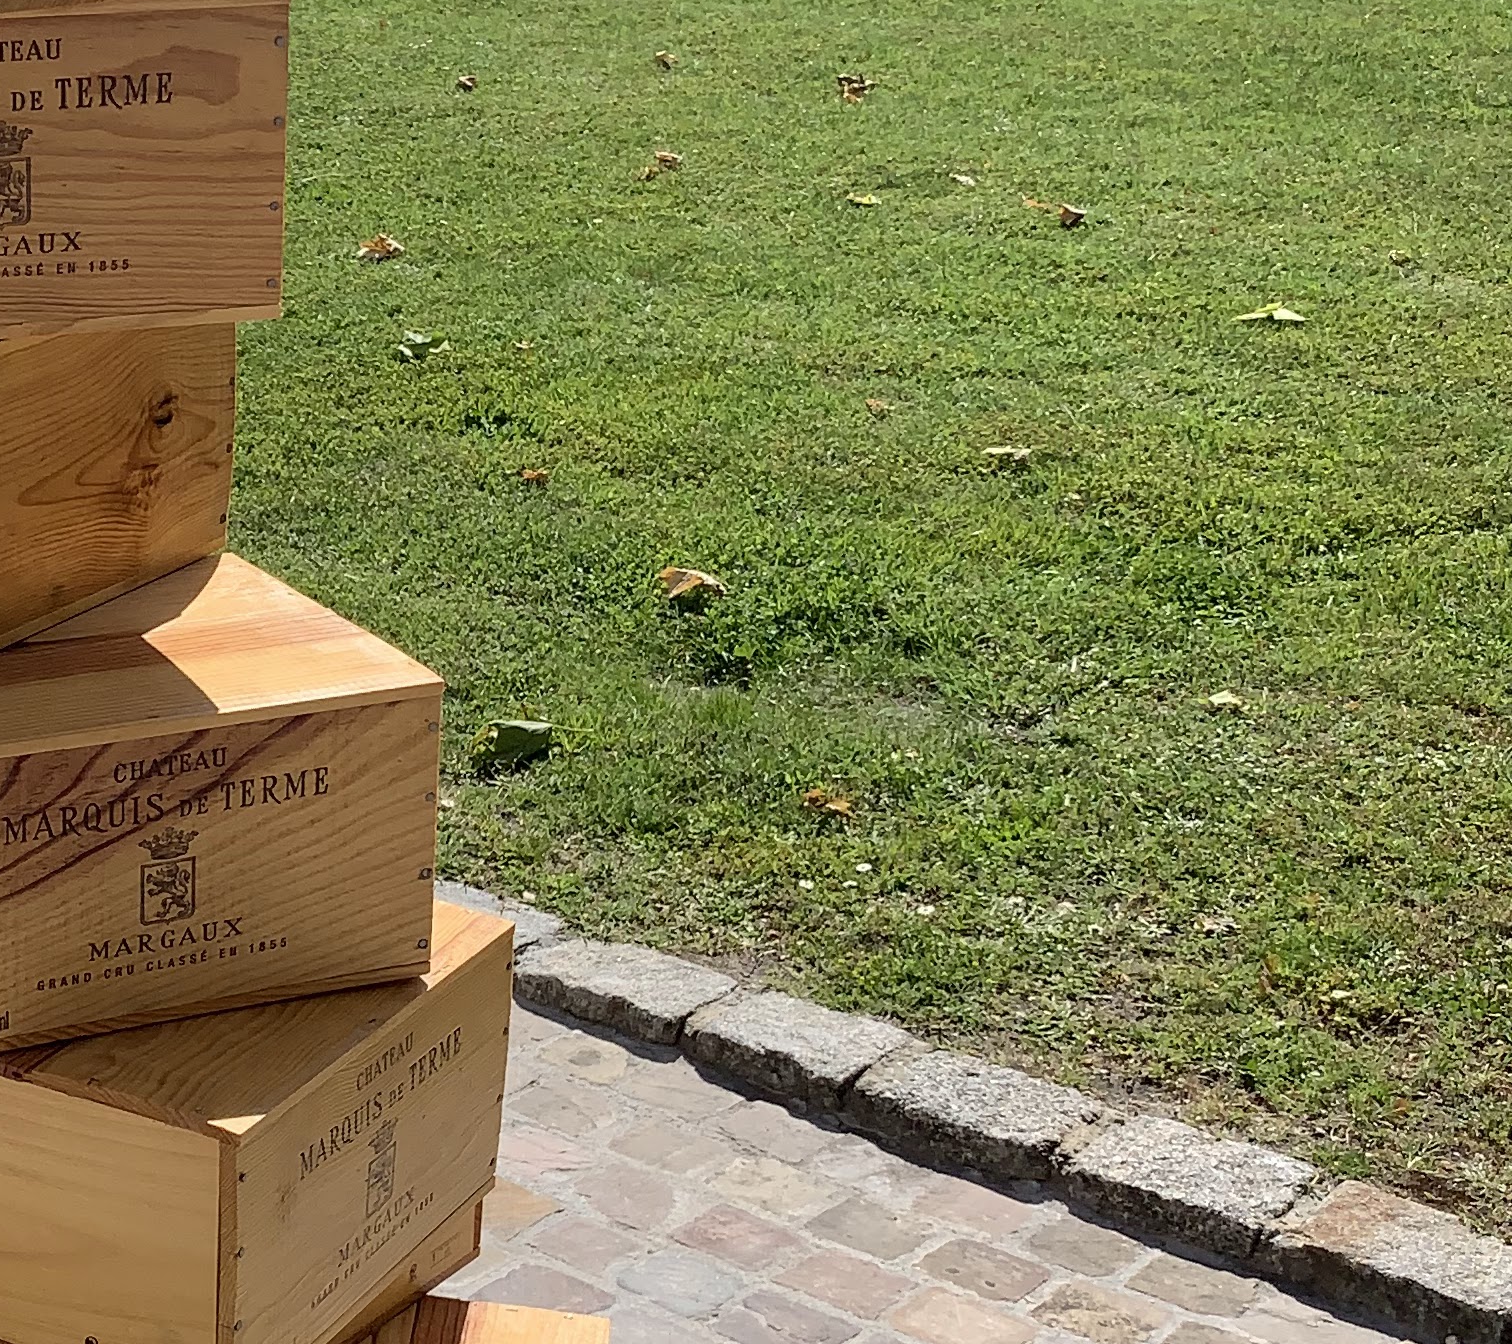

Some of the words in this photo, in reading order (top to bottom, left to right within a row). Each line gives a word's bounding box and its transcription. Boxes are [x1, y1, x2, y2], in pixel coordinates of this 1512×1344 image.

[10, 90, 44, 112] DE
[54, 72, 174, 110] TERME
[56, 262, 77, 275] EN
[88, 258, 130, 273] 1855
[113, 746, 228, 784] CHATEAU
[2, 793, 164, 846] MARQUIS
[179, 795, 209, 818] DE
[220, 766, 330, 811] TERME
[37, 971, 93, 991] GRAND
[103, 964, 135, 980] CRU
[248, 936, 289, 955] 1855
[88, 916, 244, 963] MARGAUX
[355, 1031, 414, 1092] CHATEAU
[299, 1091, 384, 1181] MARQUIS
[408, 1026, 462, 1092] TERME
[337, 1185, 416, 1268] MARGAUX
